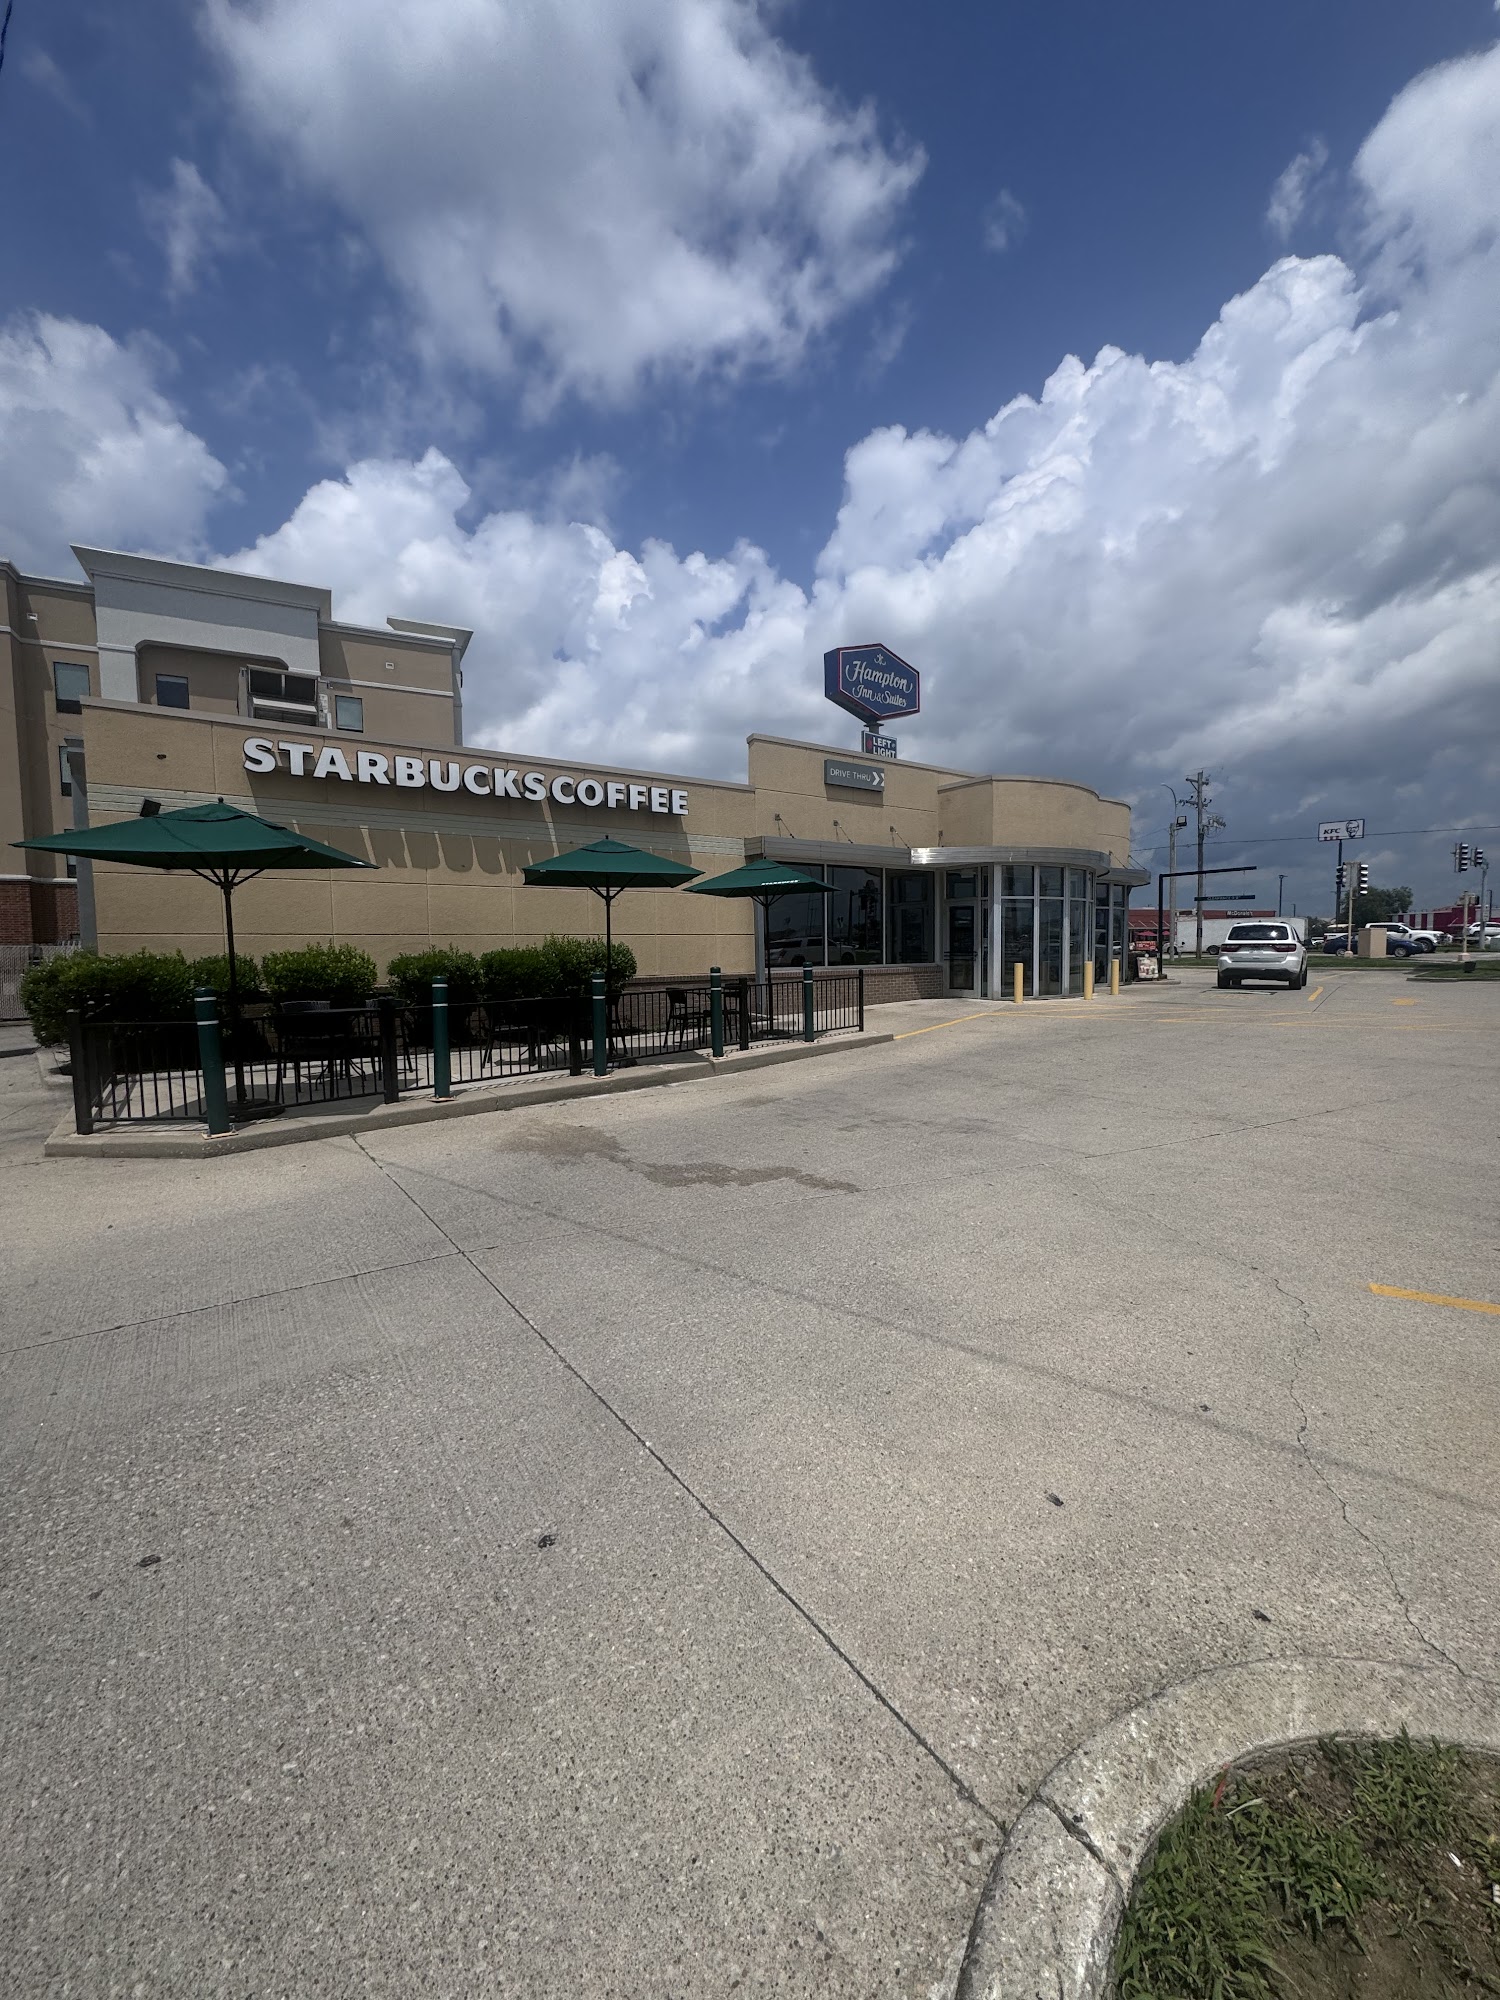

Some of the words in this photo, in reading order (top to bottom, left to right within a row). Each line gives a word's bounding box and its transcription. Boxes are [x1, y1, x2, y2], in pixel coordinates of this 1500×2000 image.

[845, 661, 913, 693] Hampton
[852, 684, 876, 701] Inn
[881, 690, 907, 708] Suites
[873, 736, 892, 748] LEFT
[873, 746, 896, 758] LIGHT
[242, 736, 546, 802] STARBUCKS
[550, 775, 689, 816] COFFEE
[830, 768, 851, 779] DRIVE
[852, 771, 871, 782] THRU
